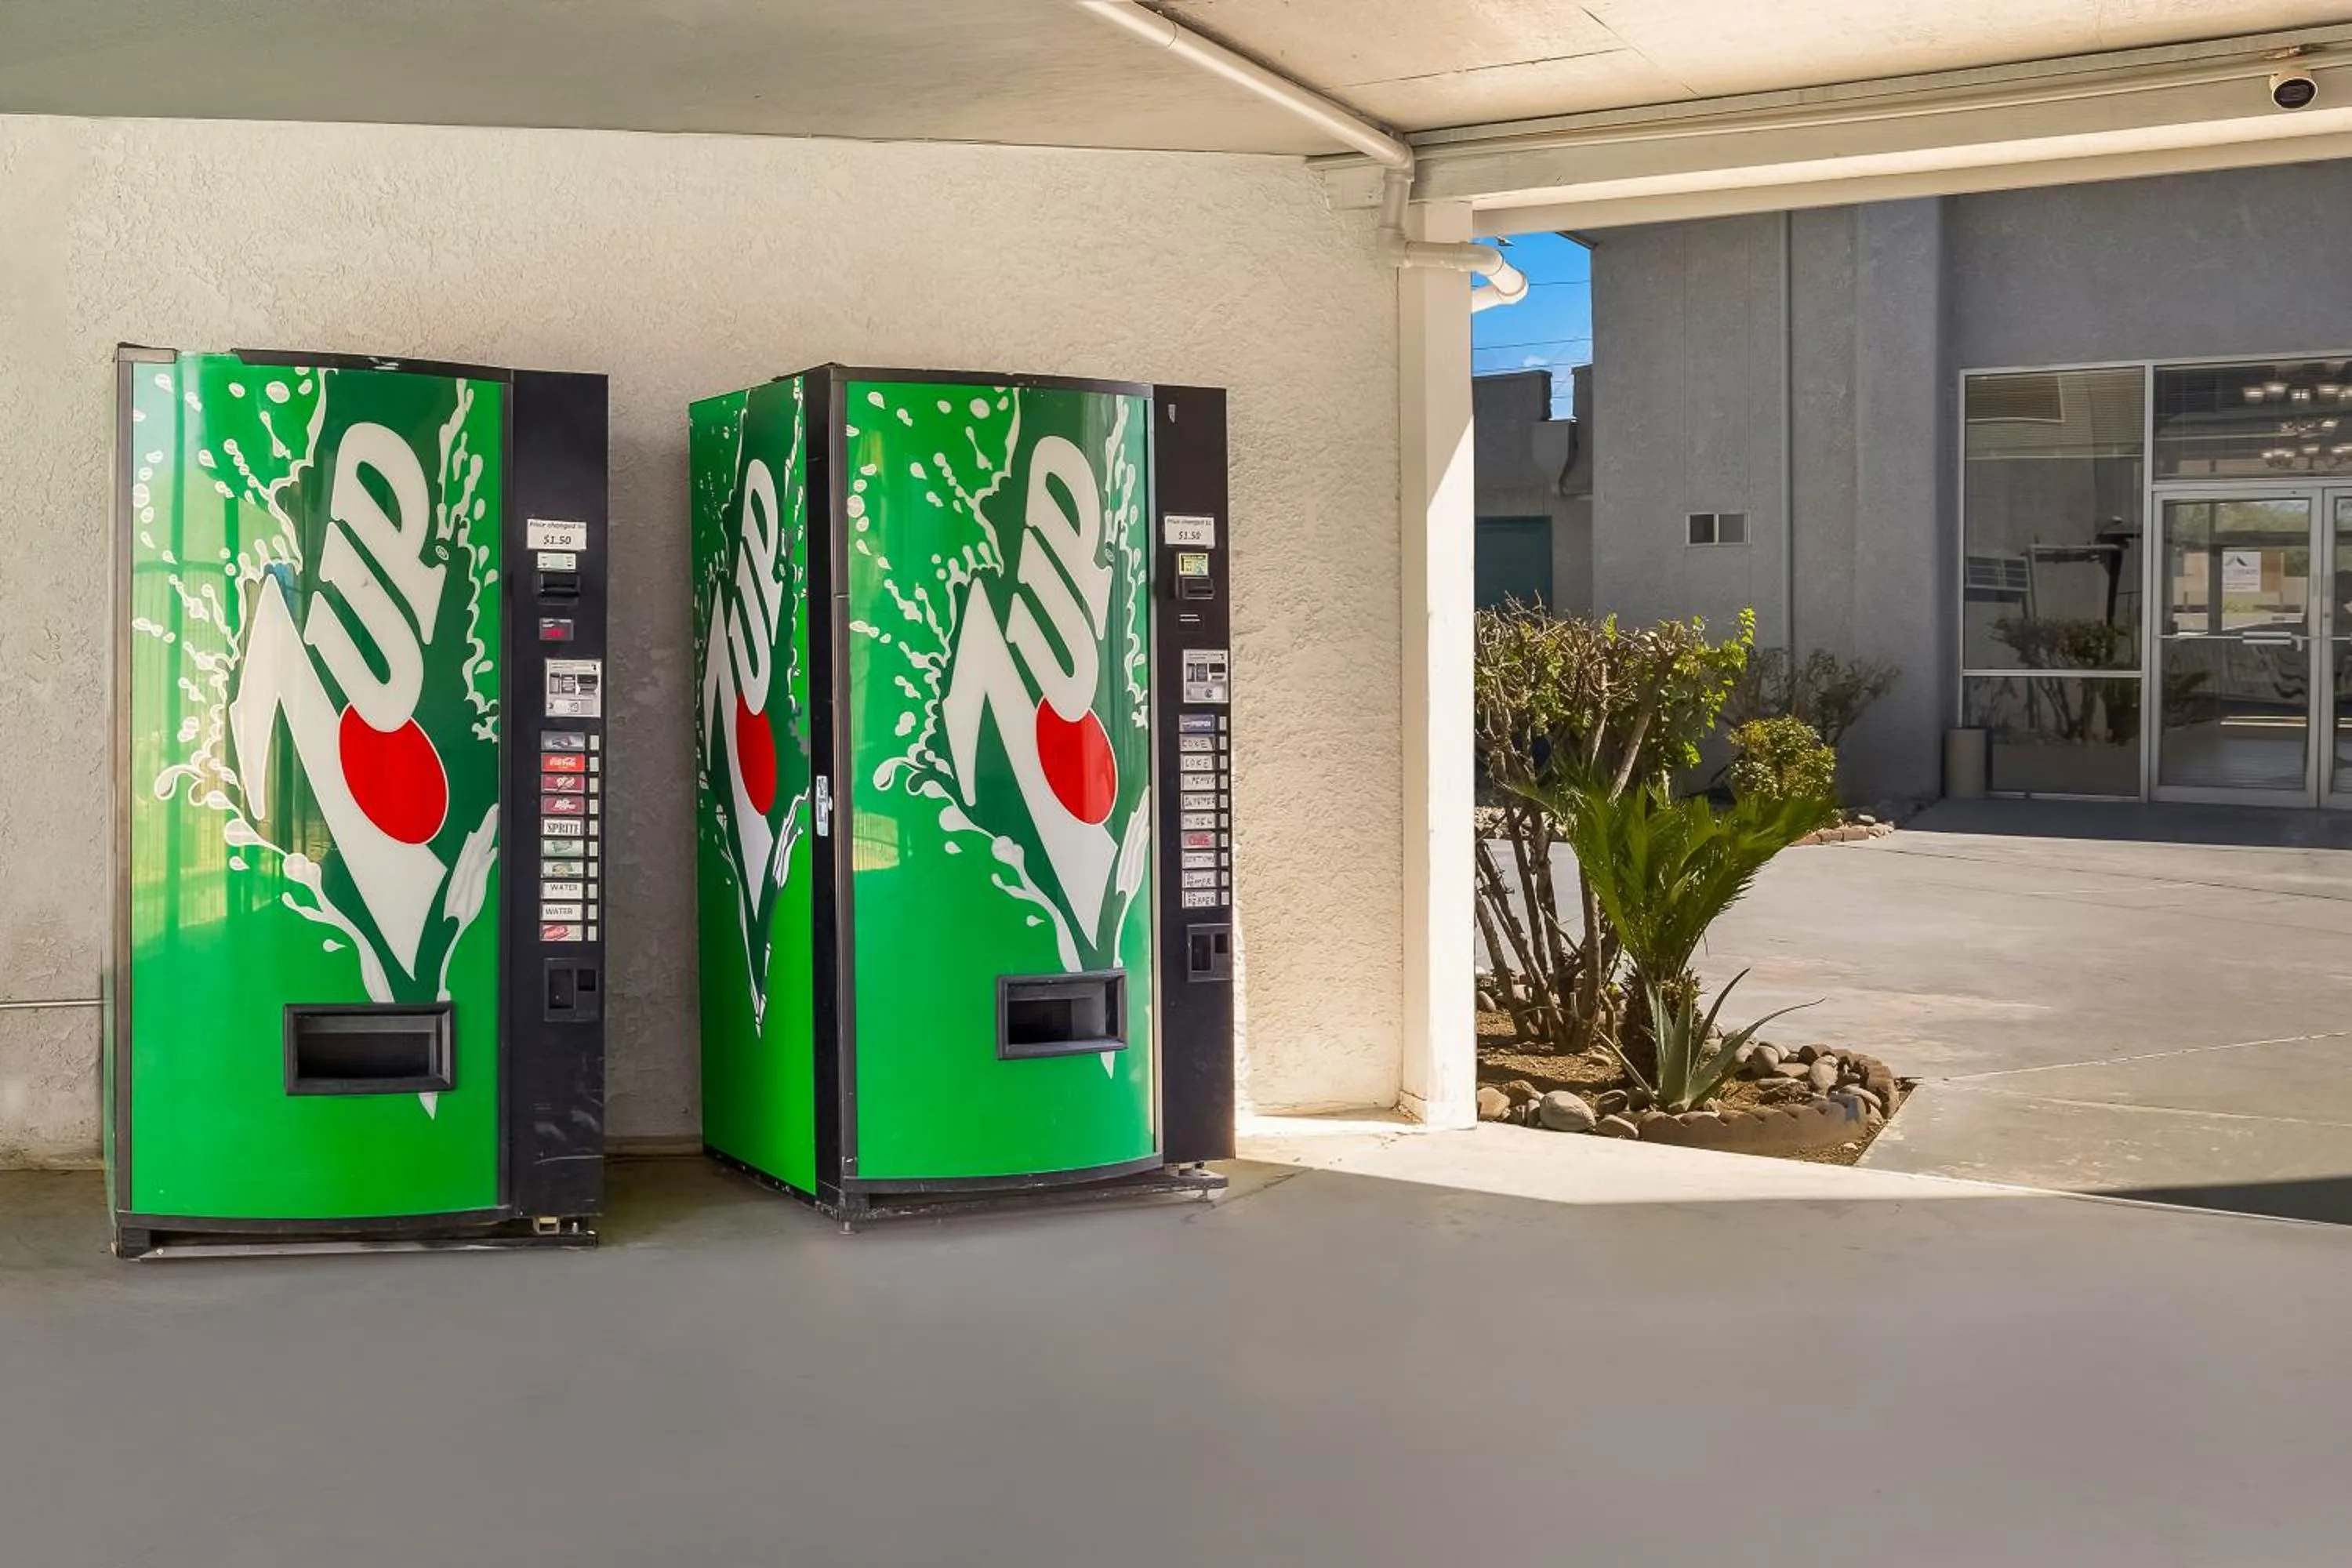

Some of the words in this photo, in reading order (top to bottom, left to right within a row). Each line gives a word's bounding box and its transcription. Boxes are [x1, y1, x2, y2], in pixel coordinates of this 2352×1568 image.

[543, 534, 572, 545] $1.50
[1178, 531, 1202, 540] $1.50
[1181, 739, 1208, 749] COKE
[1185, 758, 1209, 768] COKE
[546, 822, 579, 834] SPRITE
